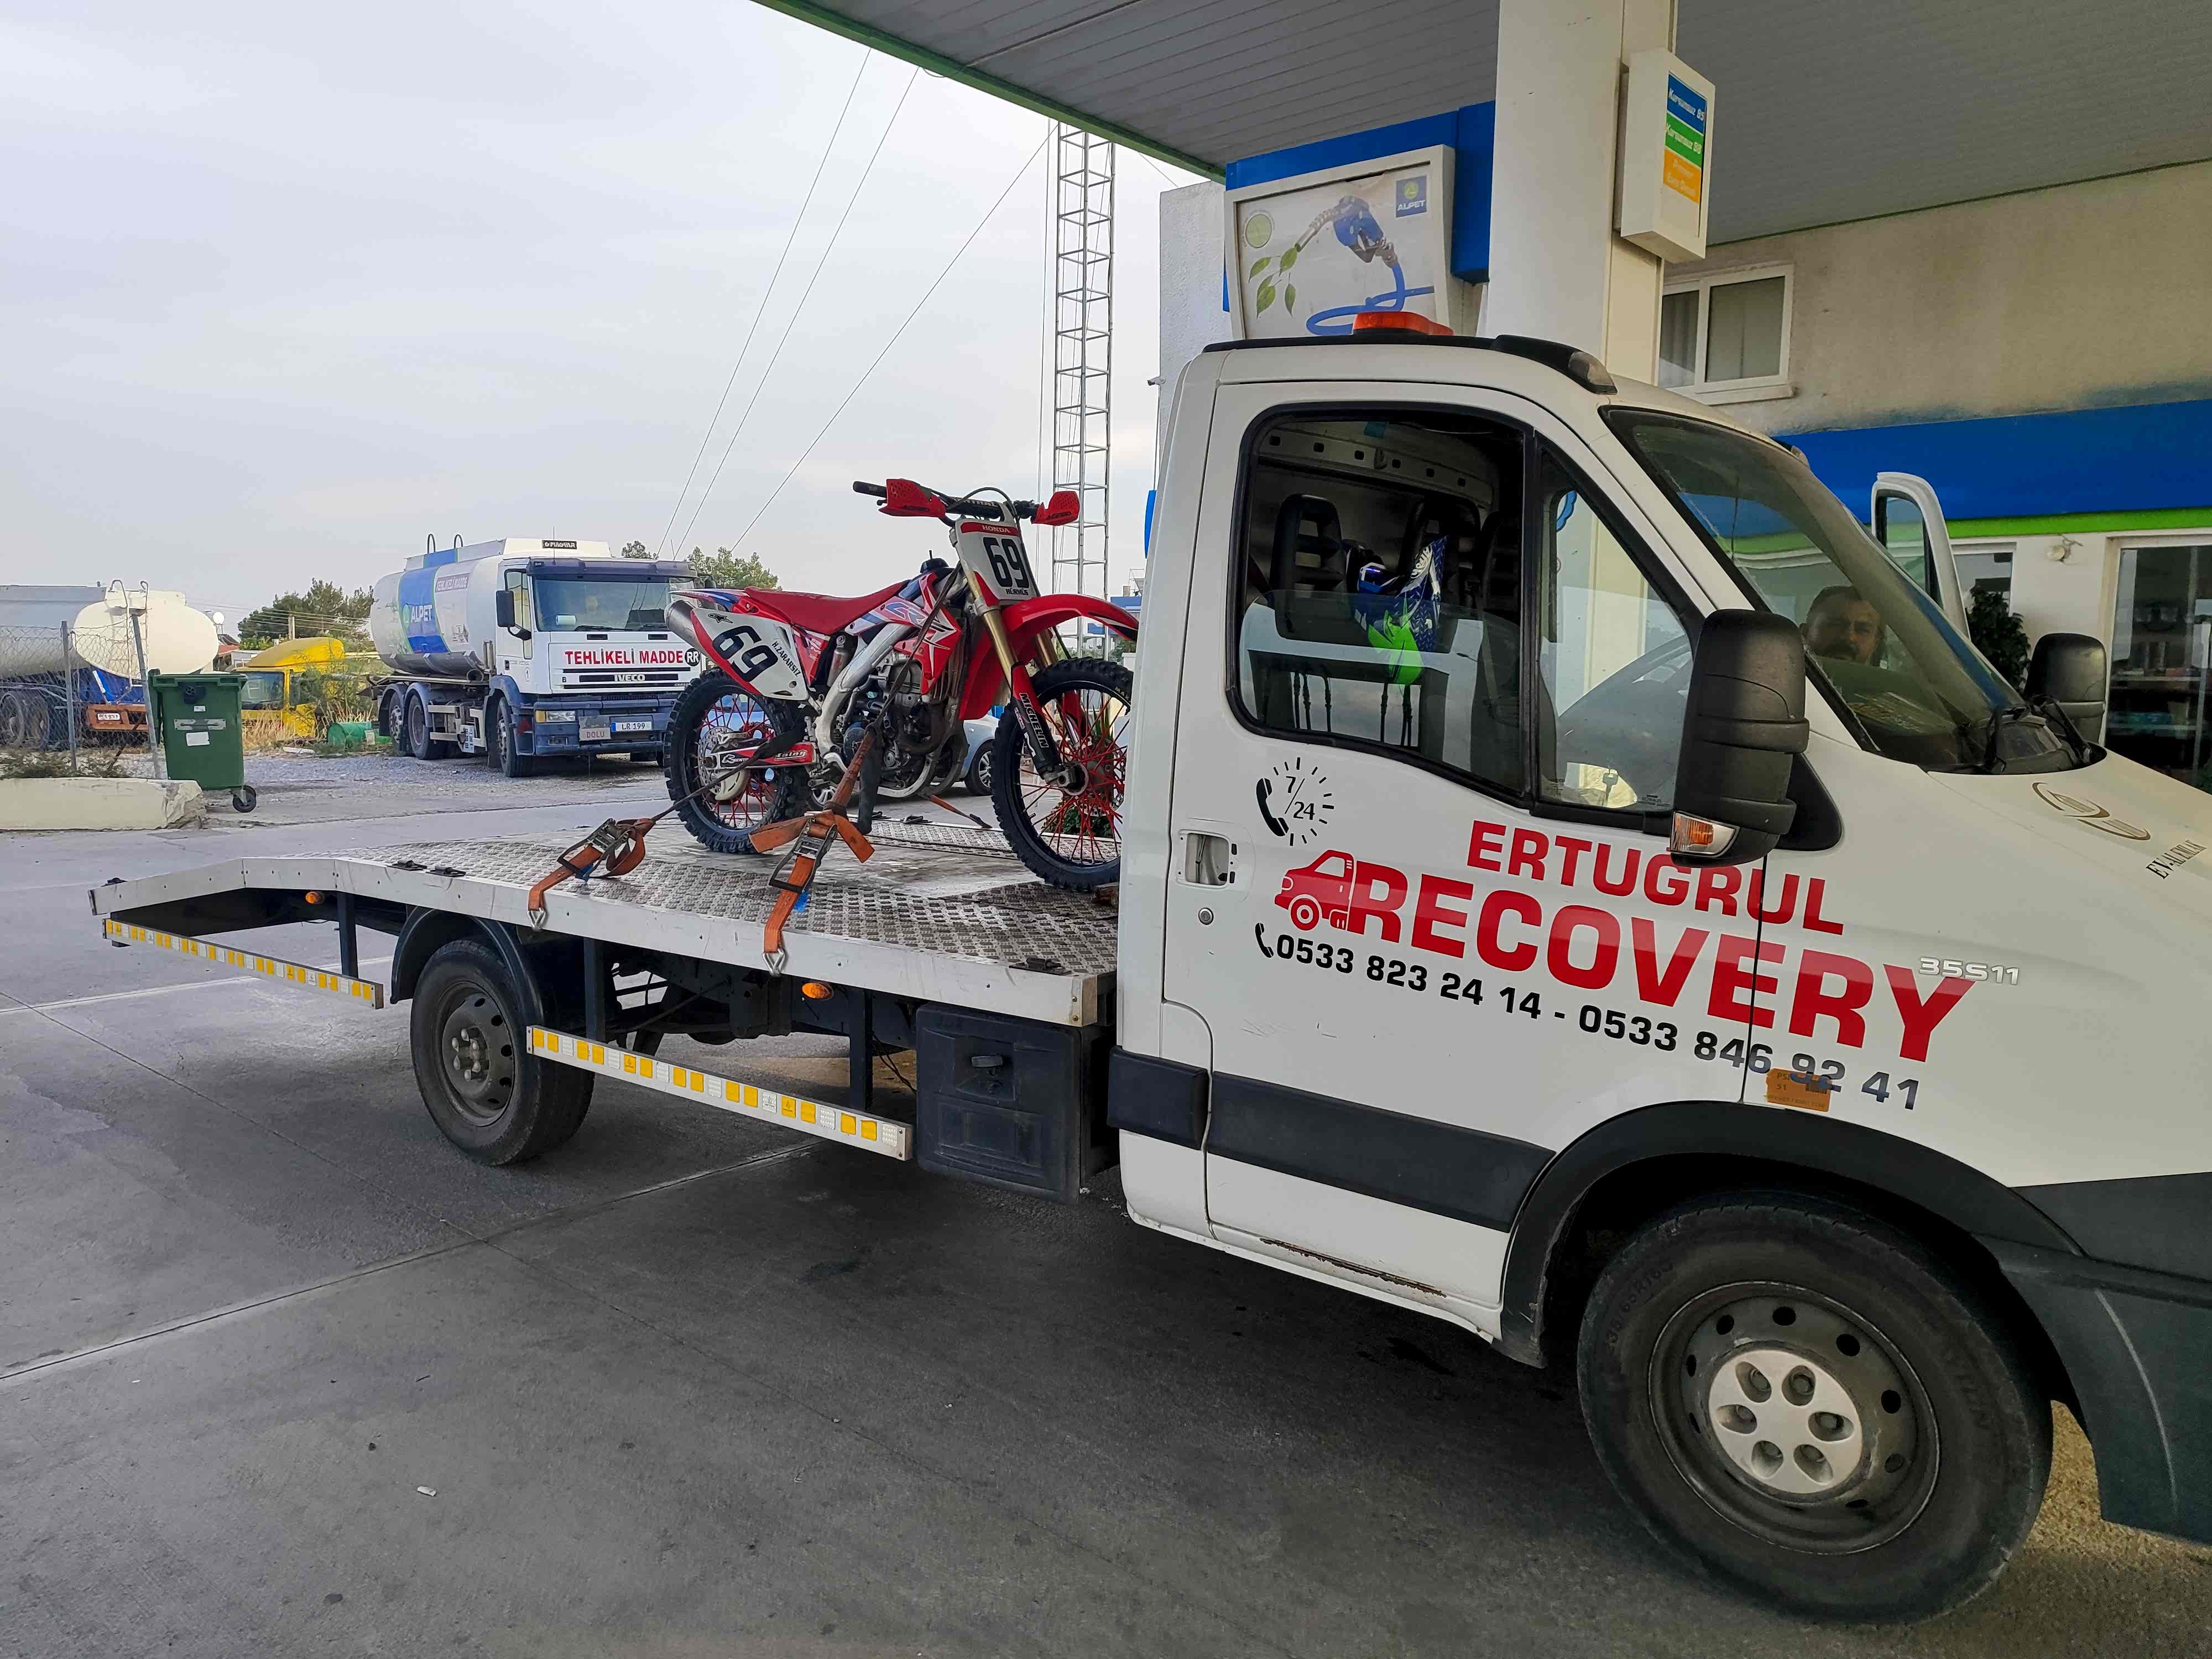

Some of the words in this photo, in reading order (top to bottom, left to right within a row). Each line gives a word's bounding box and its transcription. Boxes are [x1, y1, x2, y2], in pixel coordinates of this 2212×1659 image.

[1397, 200, 1426, 211] ALPET
[982, 525, 1011, 533] HONDA
[983, 536, 1029, 588] 69
[410, 604, 432, 623] ALPET
[639, 650, 684, 664] MADDE
[686, 651, 699, 664] RR
[712, 625, 779, 682] 69
[1019, 693, 1050, 748] MICHELIN
[1347, 860, 1976, 1062] RECOVERY
[1918, 957, 2020, 985] 35S11
[1276, 934, 1354, 974] 0533
[1366, 955, 1427, 992] 823
[1440, 972, 1483, 1005] 24
[1499, 987, 1541, 1019] 14
[1579, 1005, 1678, 1051] 0533
[1693, 1031, 1773, 1074] 846
[1790, 1053, 1845, 1093] 92
[1861, 1071, 1920, 1110] 41
